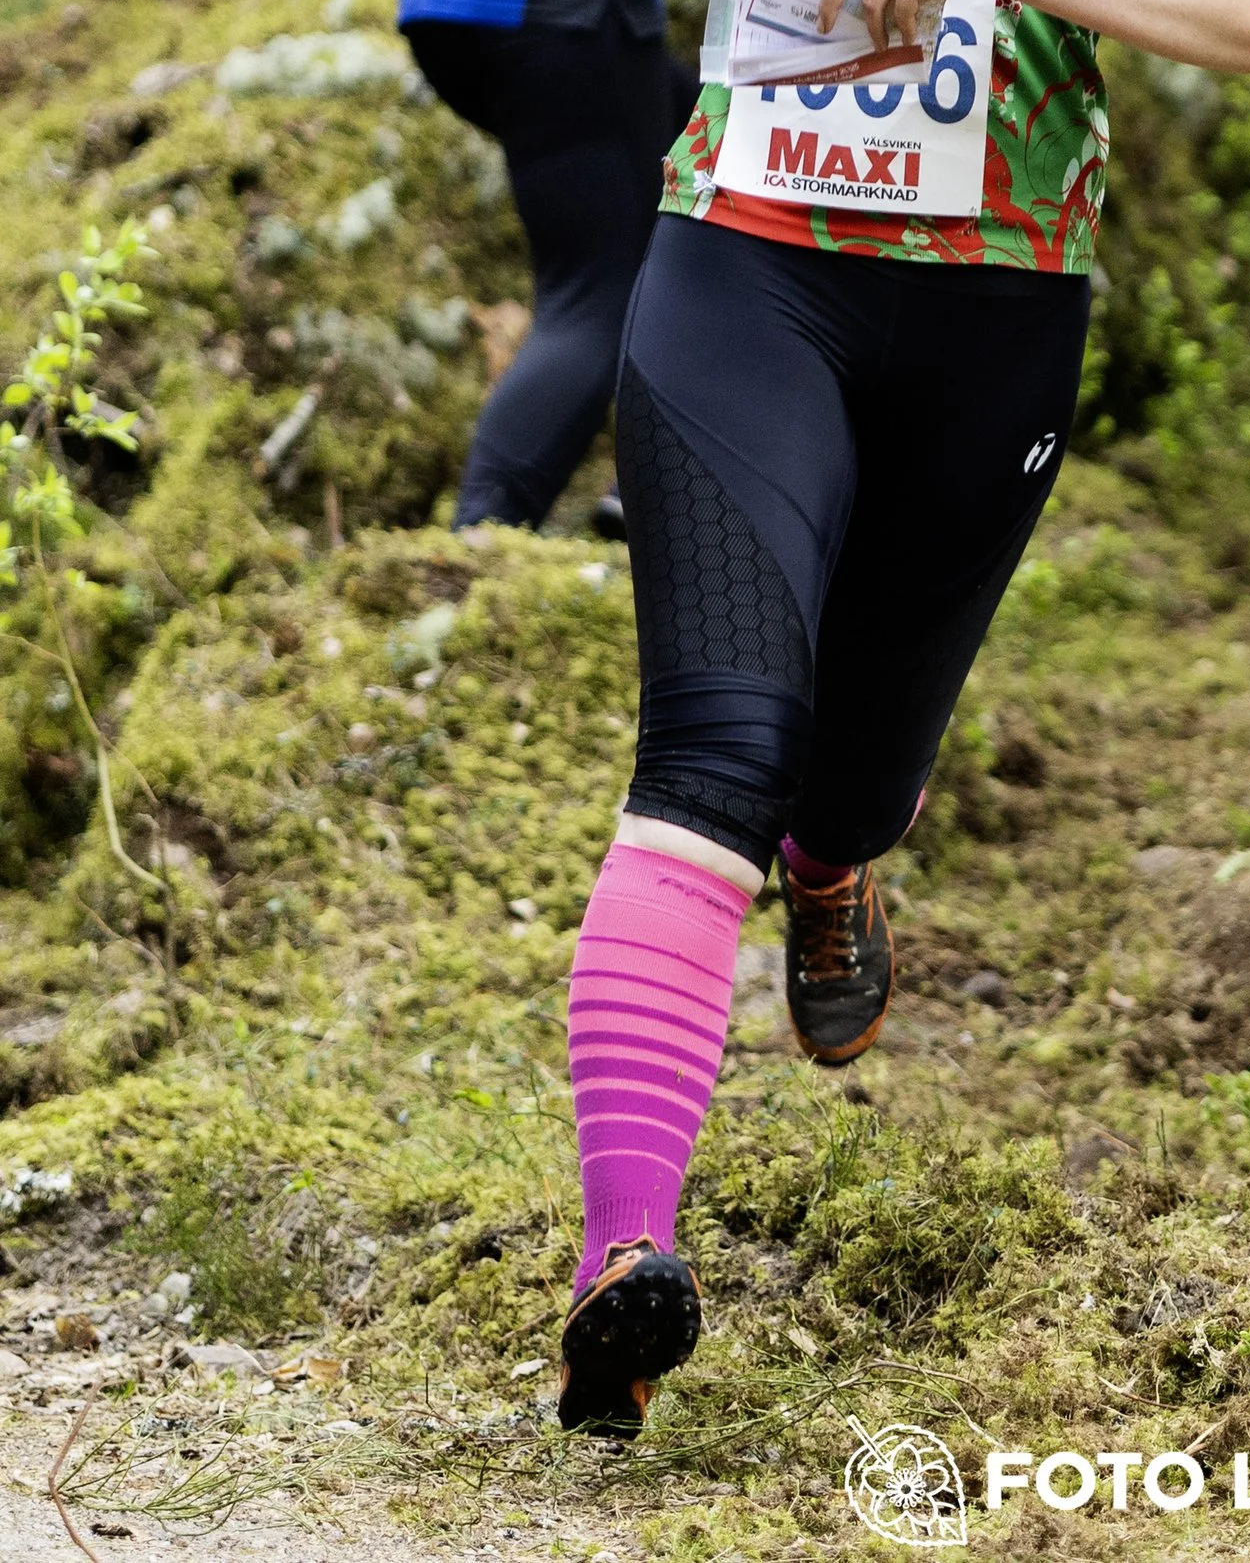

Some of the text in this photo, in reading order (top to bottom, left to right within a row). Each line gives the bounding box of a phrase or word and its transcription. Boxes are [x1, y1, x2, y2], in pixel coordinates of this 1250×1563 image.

[766, 127, 921, 187] MAXI
[862, 137, 922, 151] VÄLSVIKEN
[763, 173, 919, 203] ICA STORMARKNAD
